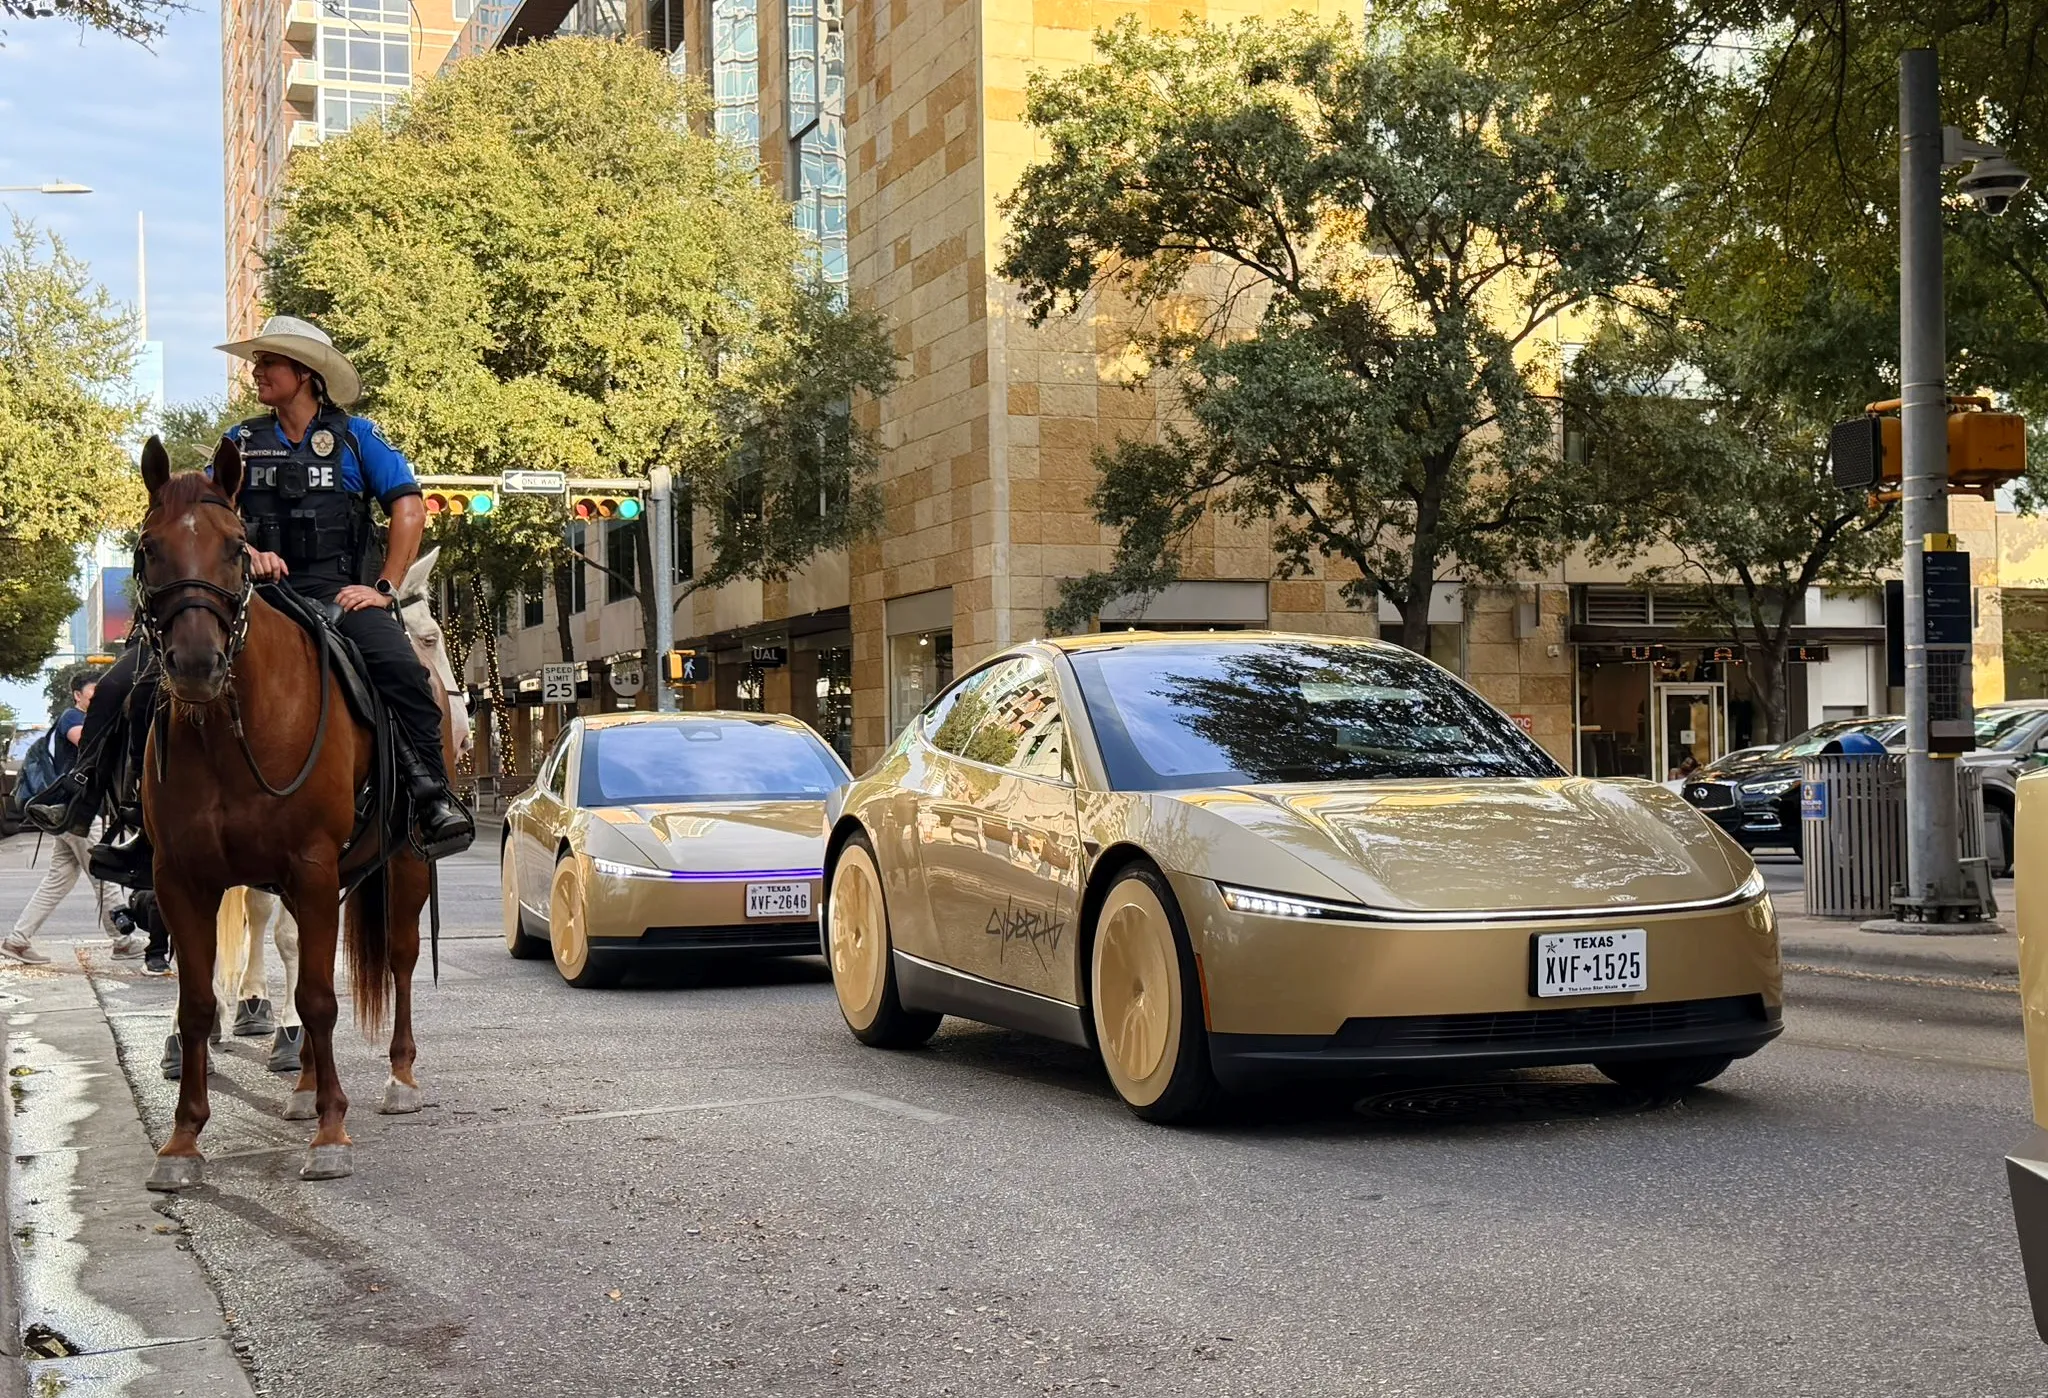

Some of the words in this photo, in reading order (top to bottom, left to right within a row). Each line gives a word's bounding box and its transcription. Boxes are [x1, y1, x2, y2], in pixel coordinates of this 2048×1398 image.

[250, 466, 334, 487] POCE
[522, 478, 538, 486] ONE
[541, 478, 557, 486] WAY
[753, 648, 779, 660] UAL
[546, 683, 572, 698] 25
[1573, 936, 1614, 949] TEXAS
[1546, 956, 1580, 984] XVF
[1592, 952, 1640, 981] 1525
